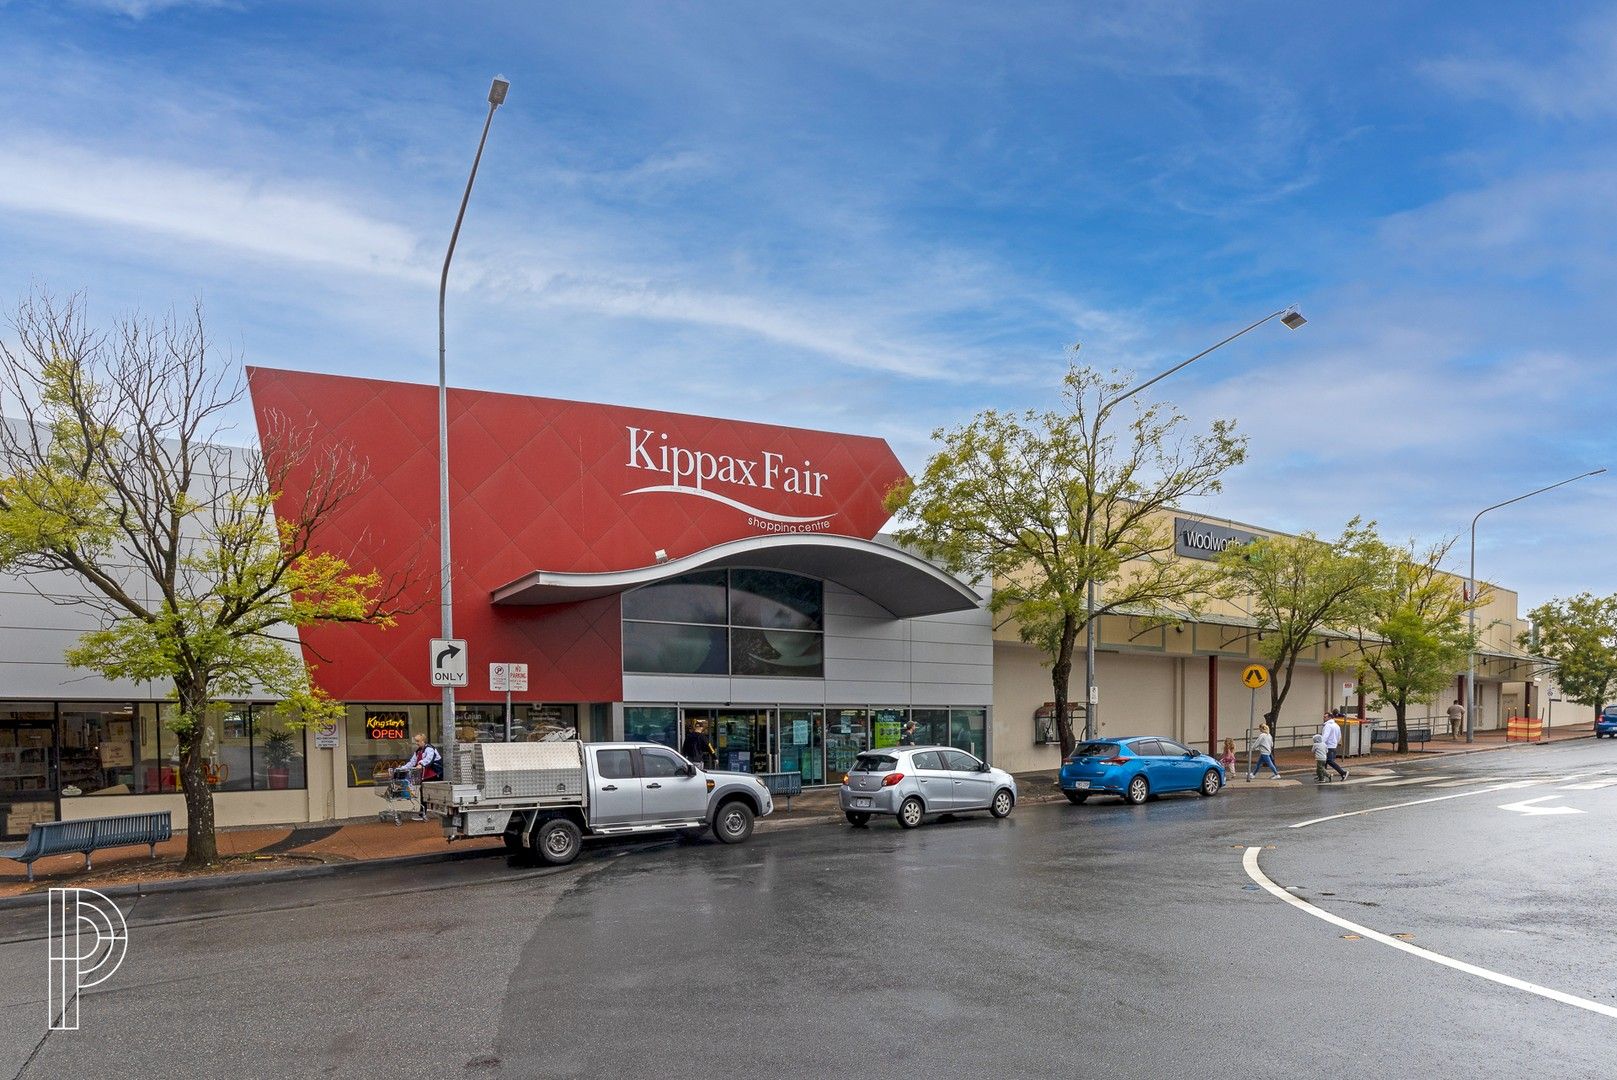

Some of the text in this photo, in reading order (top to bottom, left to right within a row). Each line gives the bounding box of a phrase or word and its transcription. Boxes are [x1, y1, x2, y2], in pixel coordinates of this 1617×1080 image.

[626, 426, 828, 497] Kippax Fair
[748, 516, 830, 534] shopping centre
[434, 672, 464, 681] ONLY
[372, 729, 403, 739] OPEN
